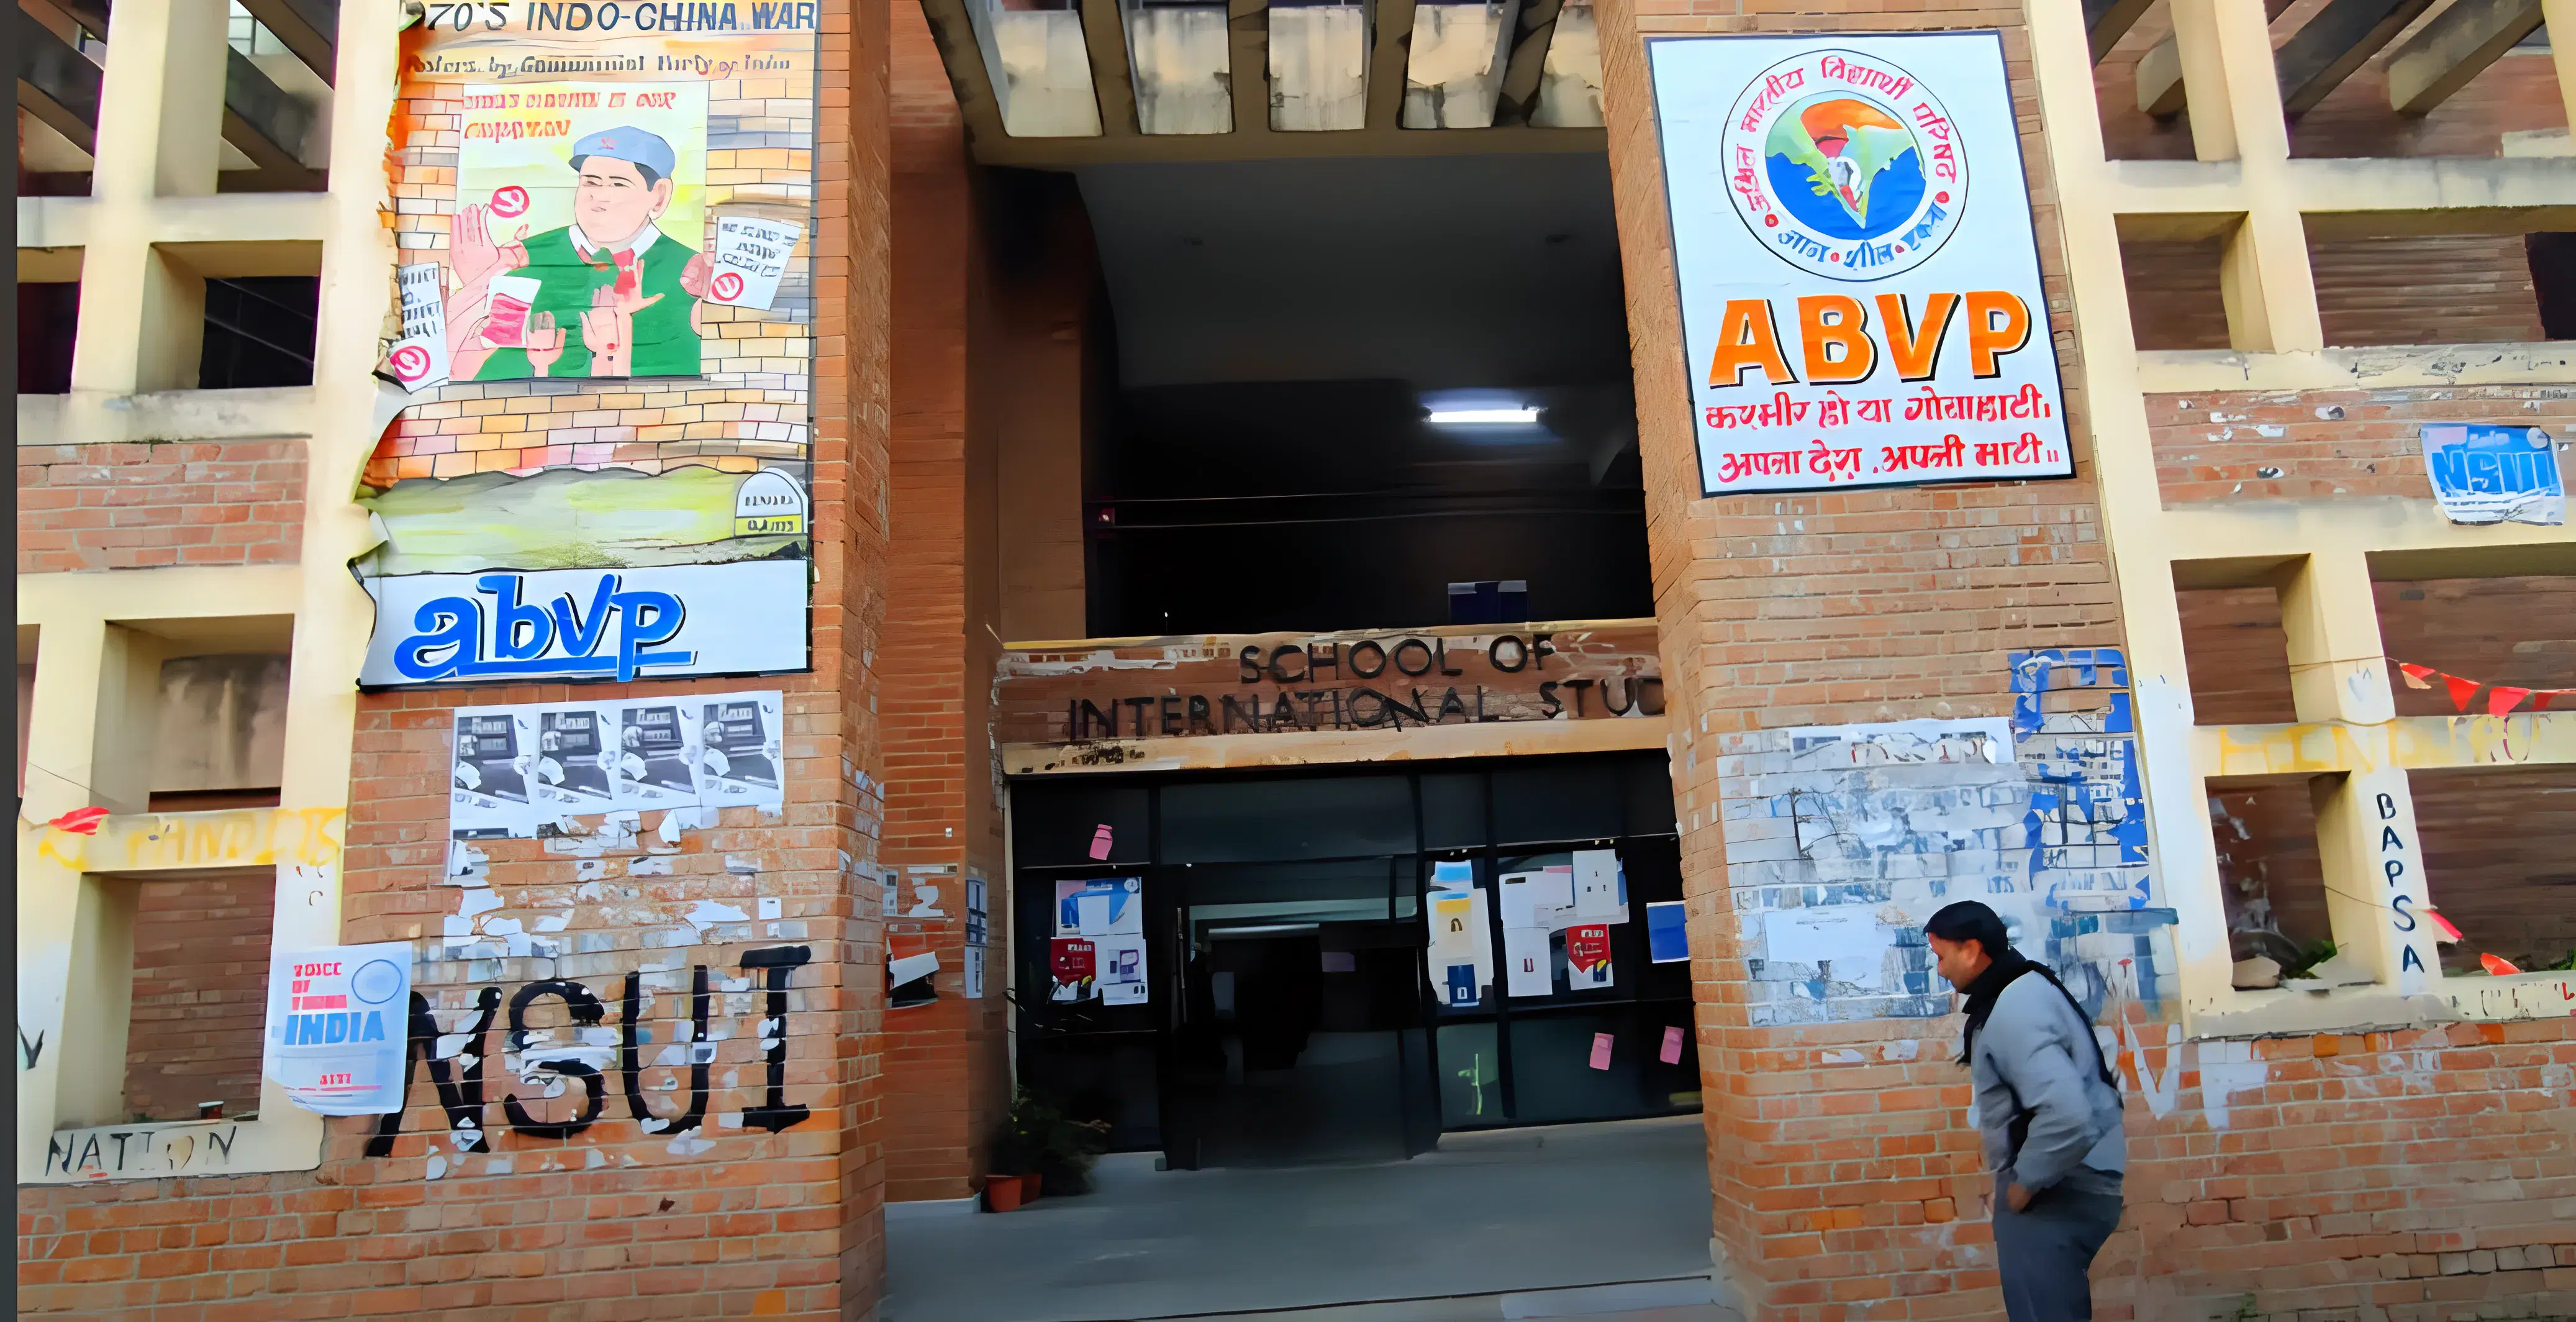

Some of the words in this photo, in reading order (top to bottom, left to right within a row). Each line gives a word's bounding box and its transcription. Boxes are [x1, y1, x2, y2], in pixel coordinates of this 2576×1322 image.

[527, 2, 737, 31] INDO-CHINA
[751, 2, 816, 30] WAR
[1708, 290, 2033, 390] ABVP
[1857, 399, 1893, 423] या
[394, 575, 687, 683] abvp
[1240, 637, 1463, 683] SCHOOL
[1489, 634, 1556, 673] OF
[1069, 684, 1499, 741] INTERNATIONAL
[2375, 793, 2425, 973] BAPSA
[283, 1010, 385, 1046] INDIA
[365, 945, 812, 1157] NSUI
[45, 1125, 237, 1177] NATION
